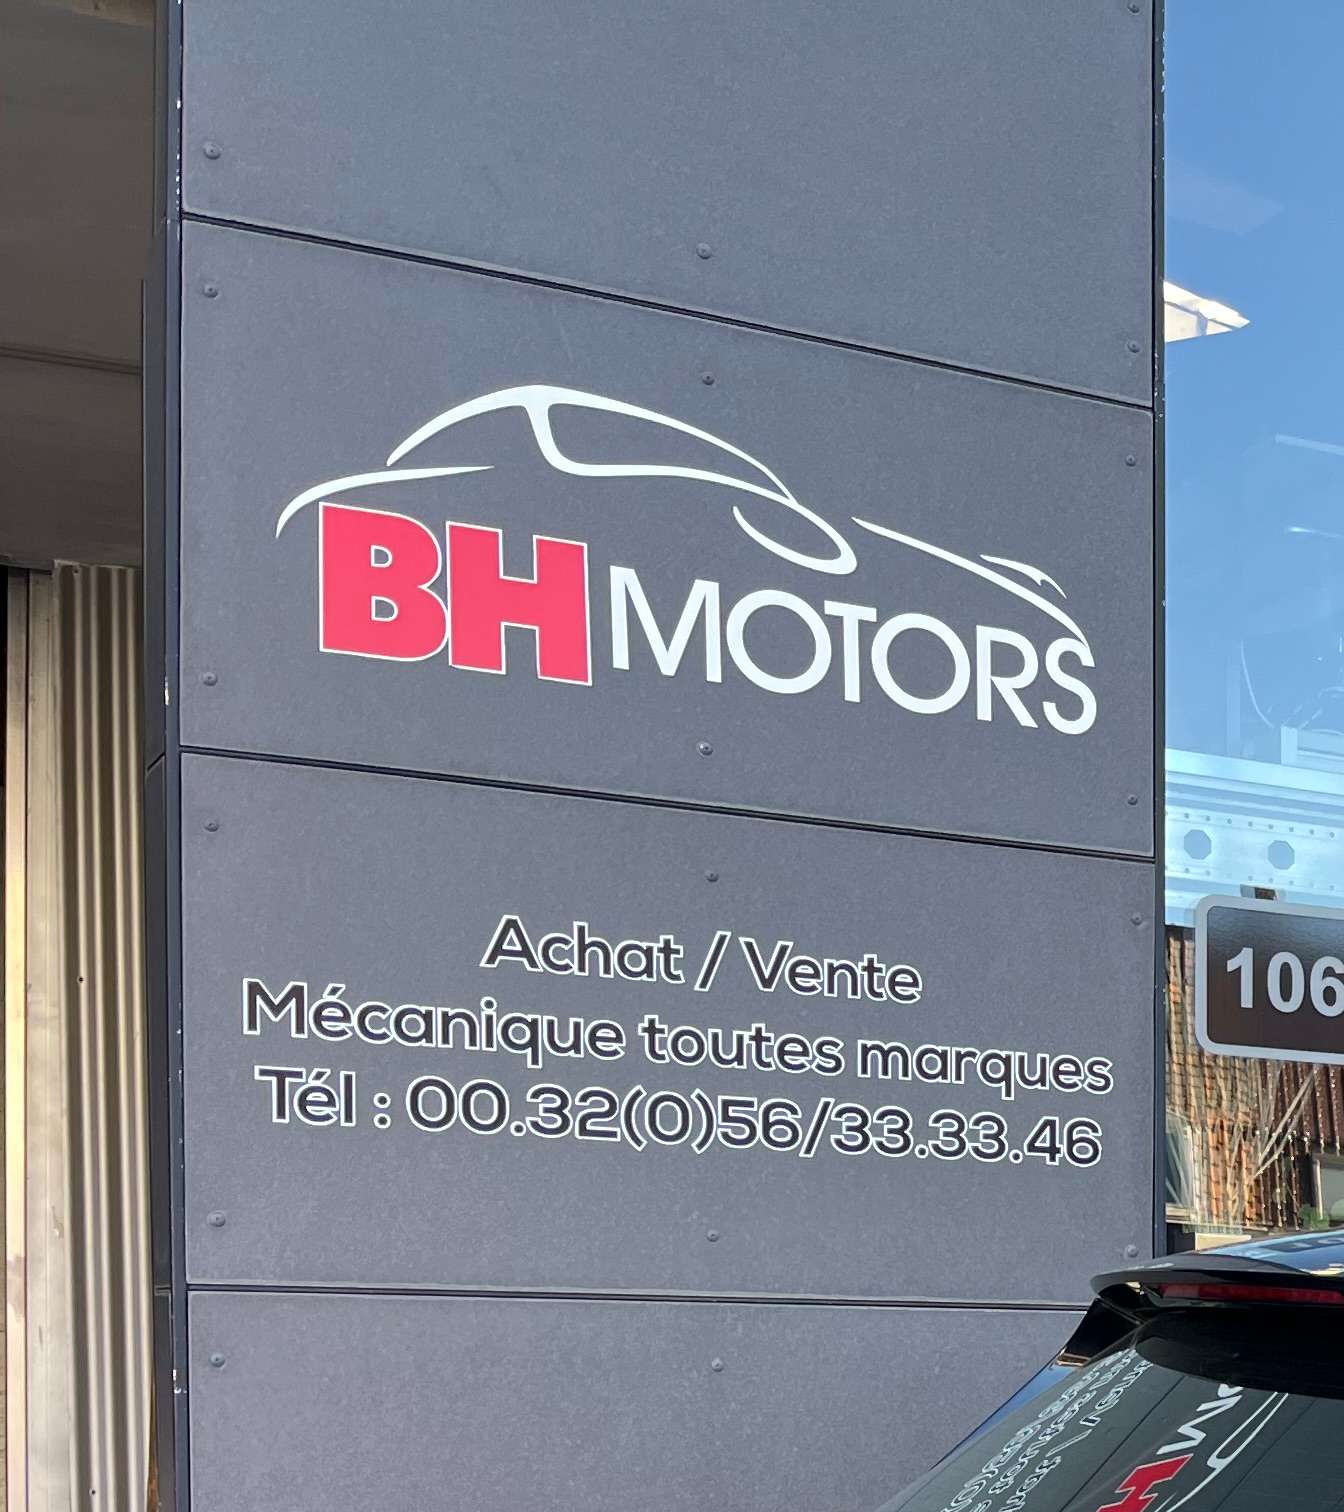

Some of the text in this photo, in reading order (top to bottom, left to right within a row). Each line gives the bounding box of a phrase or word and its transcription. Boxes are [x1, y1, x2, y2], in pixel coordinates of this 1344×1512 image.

[319, 502, 1097, 735] BH MOTORS
[480, 915, 922, 1003] Achat / Vente
[243, 978, 1113, 1100] Mécanique toutes marques
[405, 1076, 1102, 1168] 00.32(0)56/33.33.46
